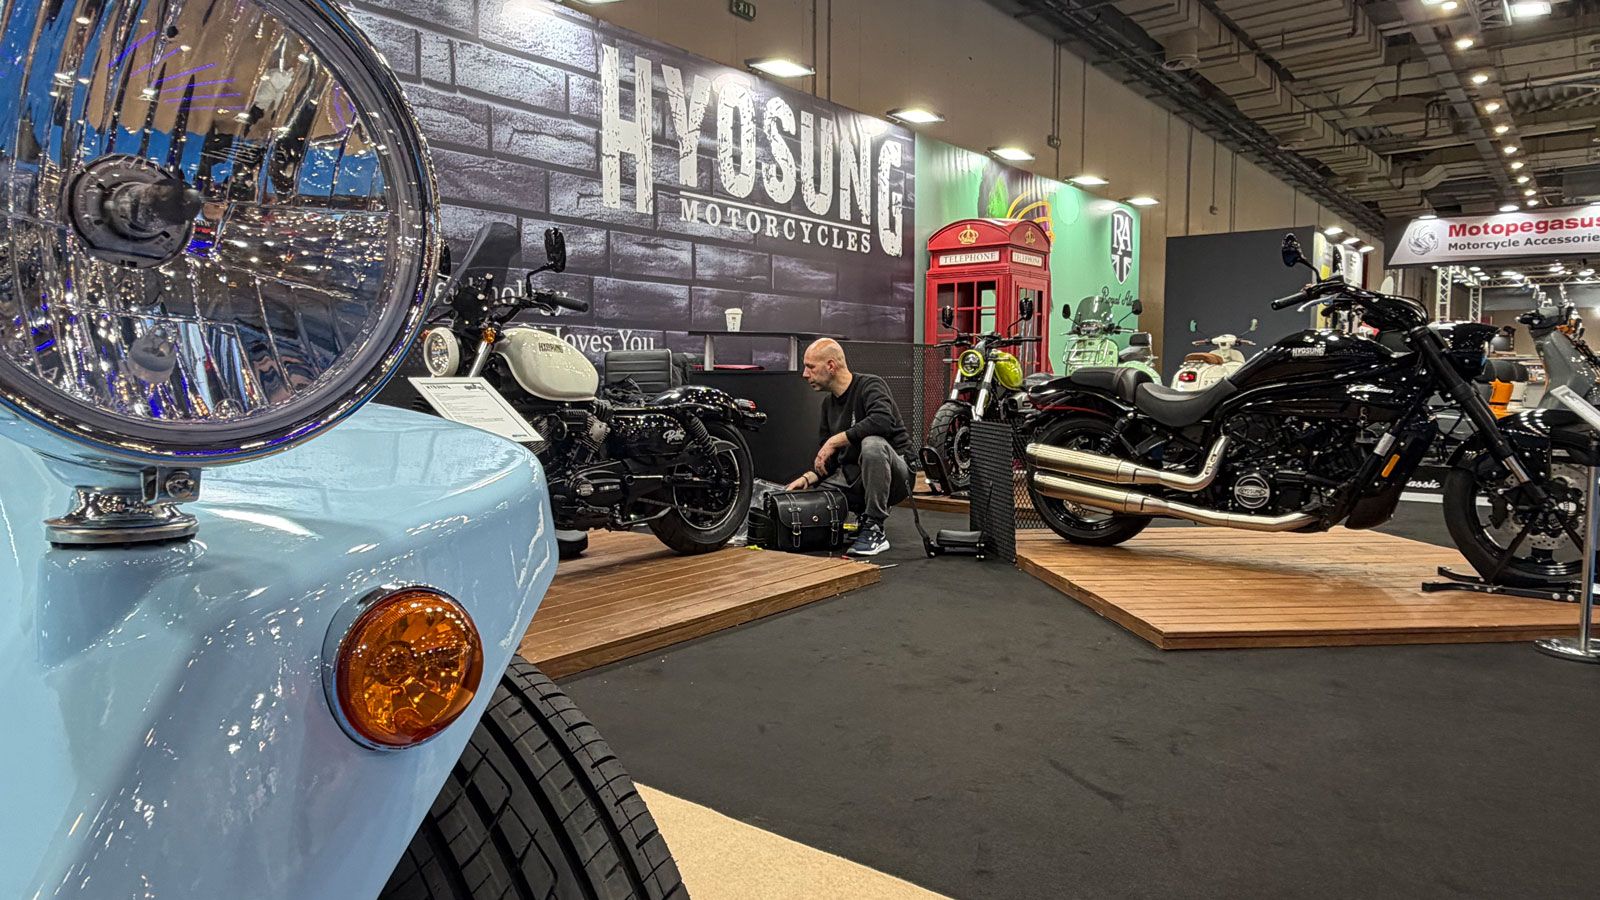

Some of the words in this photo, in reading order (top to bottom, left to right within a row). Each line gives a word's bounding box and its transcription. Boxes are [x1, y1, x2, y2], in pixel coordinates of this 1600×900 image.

[601, 43, 903, 258] HYOSUNG
[679, 198, 872, 254] MOTORCYCLES
[1448, 238, 1520, 251] Motorcycle
[943, 252, 996, 264] TELEPHONE
[1013, 253, 1041, 264] TELEPHONE
[617, 329, 655, 351] You
[1292, 347, 1326, 357] HYOSUNG
[1405, 477, 1441, 489] assic
